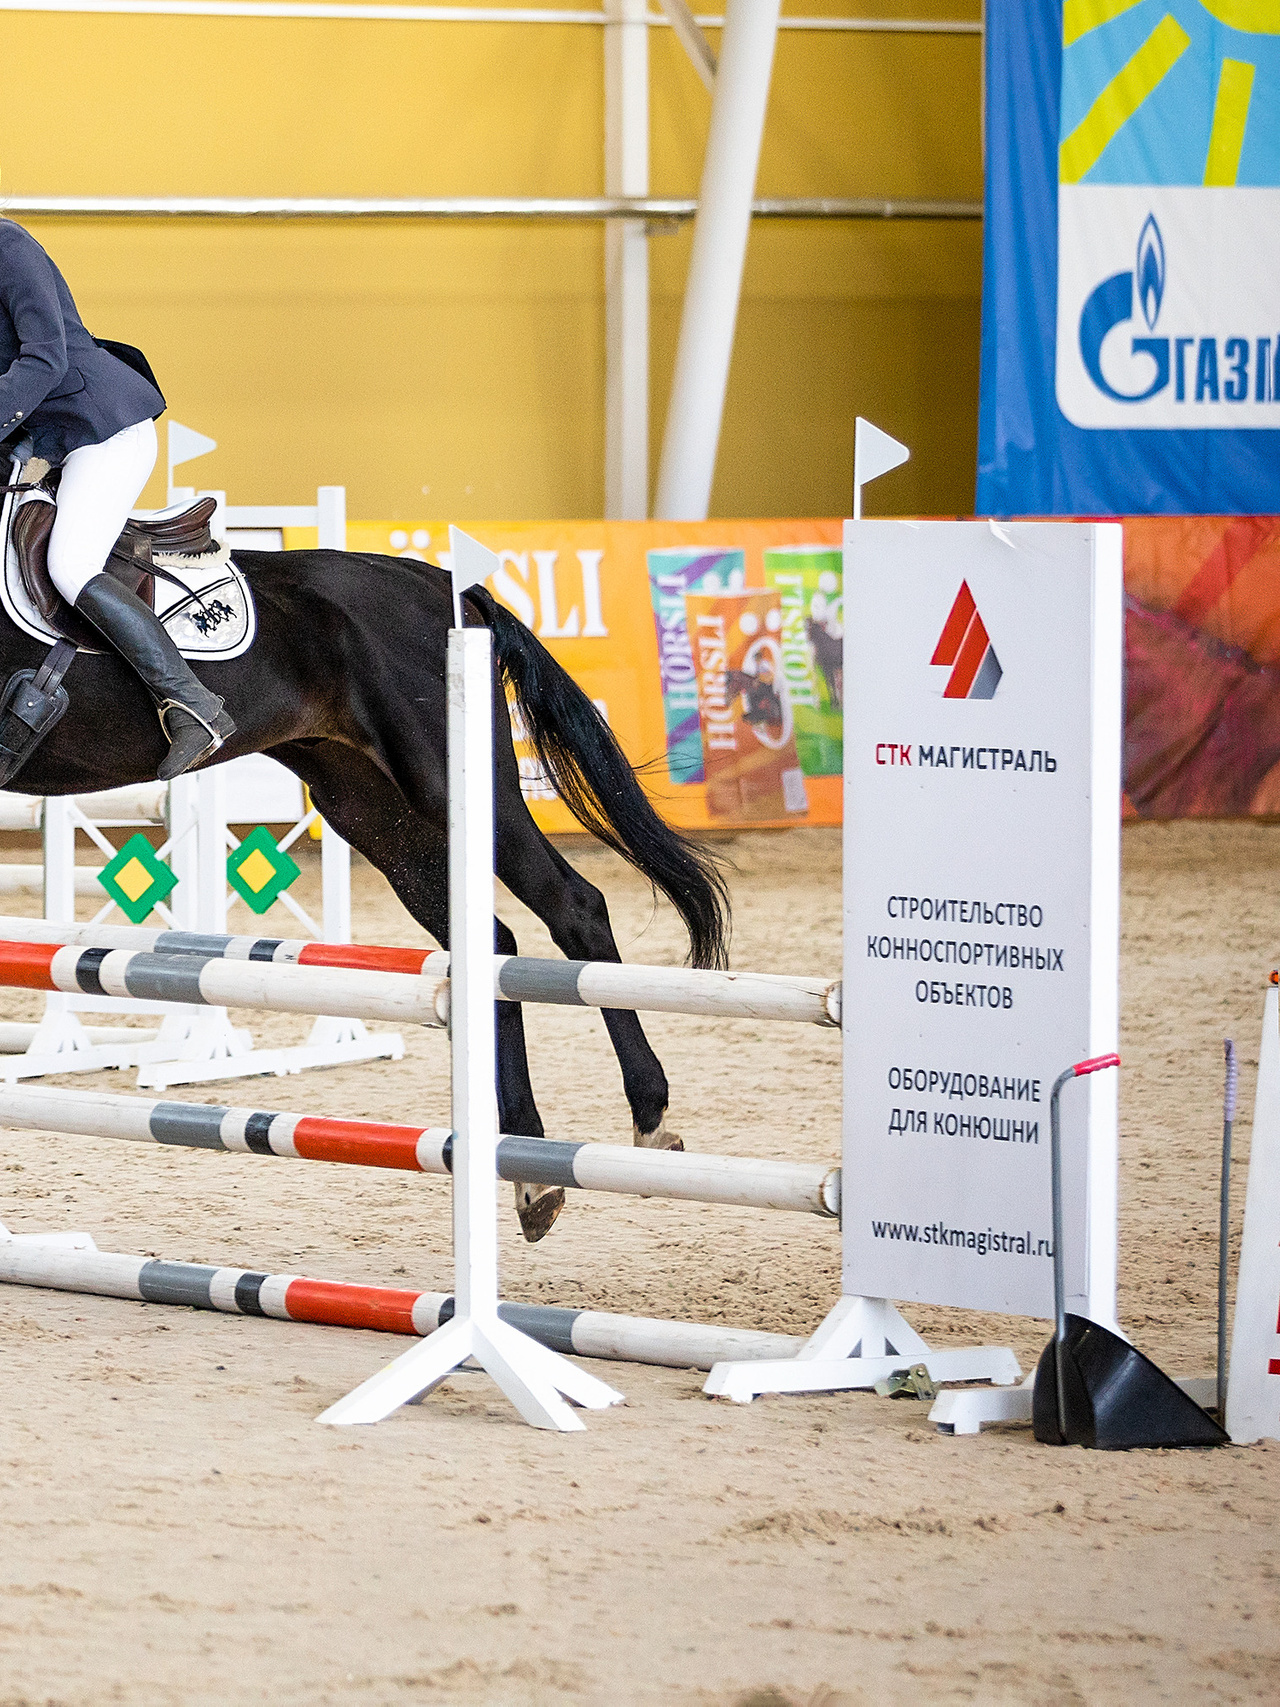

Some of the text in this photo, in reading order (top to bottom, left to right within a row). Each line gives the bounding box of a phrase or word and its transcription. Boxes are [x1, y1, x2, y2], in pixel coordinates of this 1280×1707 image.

[696, 613, 737, 750] HÖRSLI
[875, 742, 1058, 774] СТК МАГИСТРАЛЬ
[886, 895, 1044, 929] СТРОИТЕЛЬСТВО
[866, 935, 1065, 972] КОННОСПОРТИВНЫХ
[914, 979, 1014, 1010] ОБЪЕКТОВ
[887, 1066, 1042, 1104] ОБОРУДОВАНИЕ
[888, 1107, 1040, 1145] ДЛЯ КОНЮШНИ
[871, 1219, 1057, 1257] www.stkmagistral.ru
